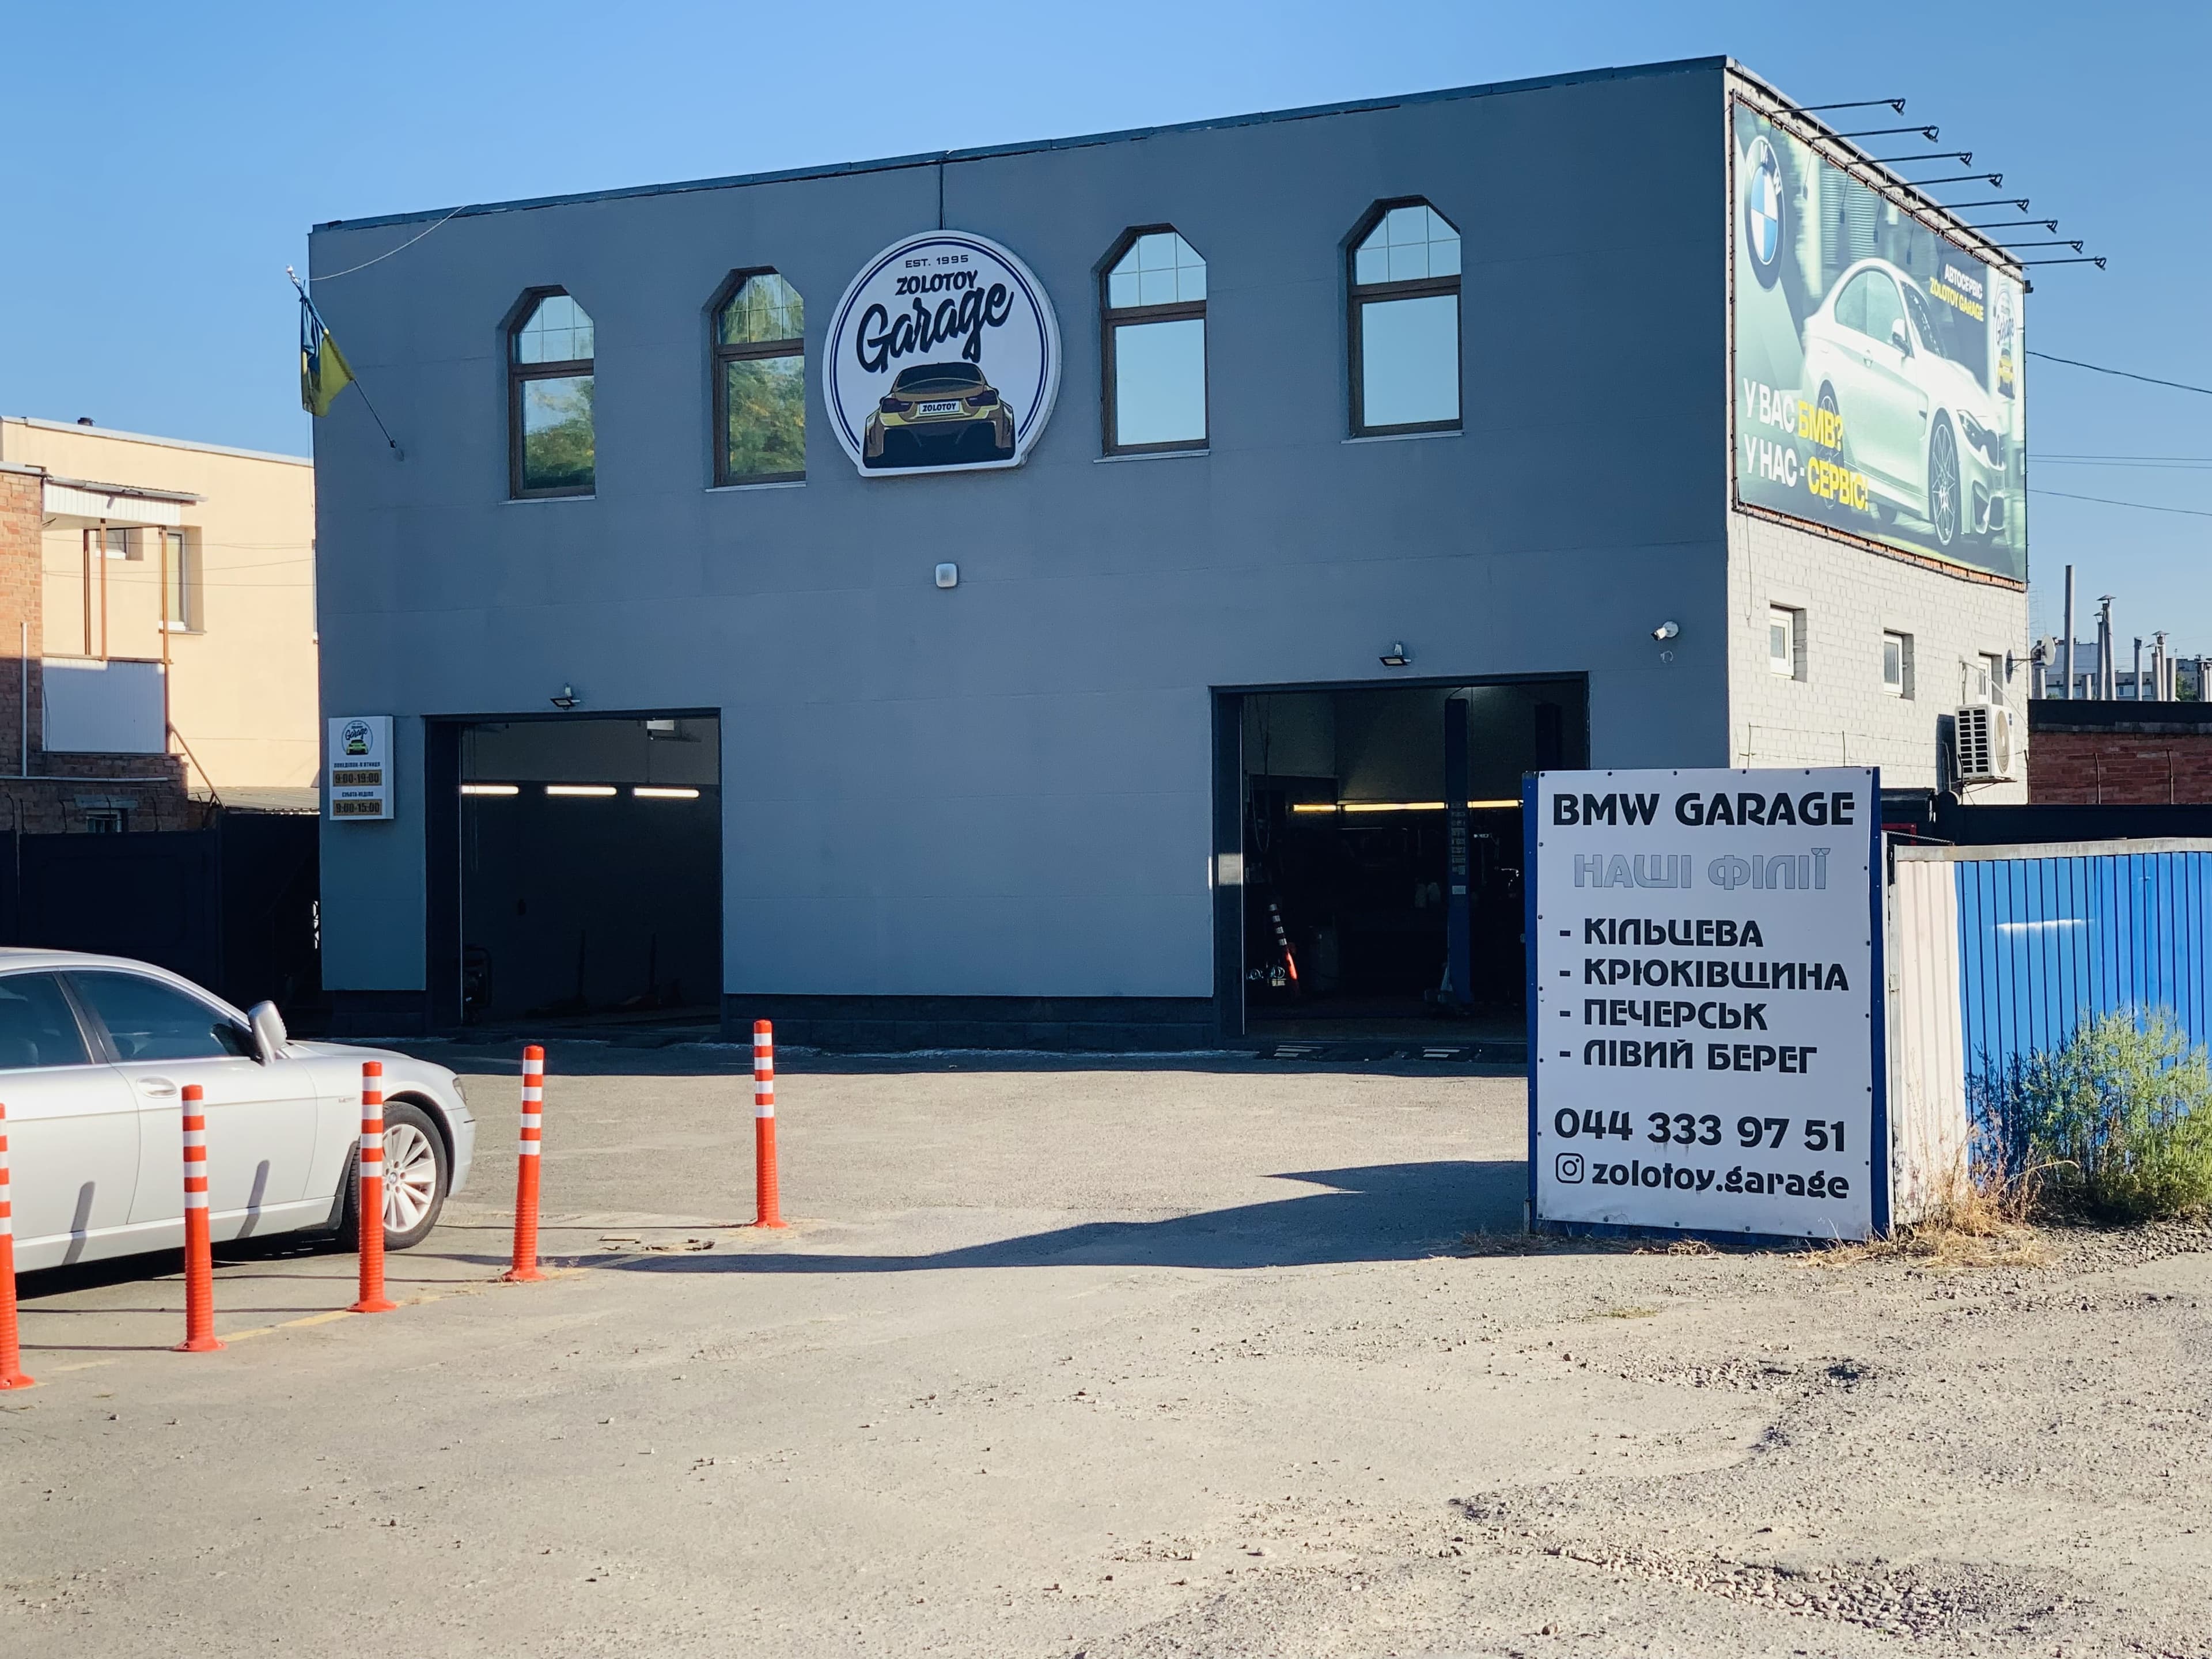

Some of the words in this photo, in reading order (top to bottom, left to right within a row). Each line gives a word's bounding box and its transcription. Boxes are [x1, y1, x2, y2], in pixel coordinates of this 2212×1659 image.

[906, 259, 931, 268] EST.
[937, 255, 968, 264] 1995
[895, 270, 978, 296] ZOLOTOY
[1930, 276, 1959, 308] ZOLOTOY
[1945, 264, 1983, 300] АВТОСЕРВІС
[857, 283, 1014, 373] Garage
[922, 403, 956, 412] ZOLOTOY
[1743, 377, 1756, 418] У
[1759, 384, 1795, 433] ВАС
[1797, 400, 1843, 452] БМВ?
[1744, 433, 1757, 474] У
[1760, 438, 1797, 487] НАС
[1808, 456, 1869, 512] СЕРВІС!
[1554, 793, 1660, 825] BMW
[1676, 792, 1854, 826] GARAGE
[1574, 854, 1691, 888] НАШІ
[1708, 848, 1831, 890] ФІЛІЇ
[1585, 918, 1763, 948] КІЛЬЦЕВА
[1585, 959, 1849, 991] КРЮКІВЩИНА
[1585, 999, 1768, 1031] ПЕЧЕРСЬК
[1584, 1039, 1693, 1070] ЛІВИЙ
[1708, 1044, 1817, 1074] БЕРЕГ
[1555, 1108, 1633, 1141] 044
[1647, 1112, 1722, 1145] 333
[1737, 1116, 1790, 1149] 97
[1804, 1120, 1844, 1152] 51
[1592, 1160, 1850, 1199] zolotoy.garage
